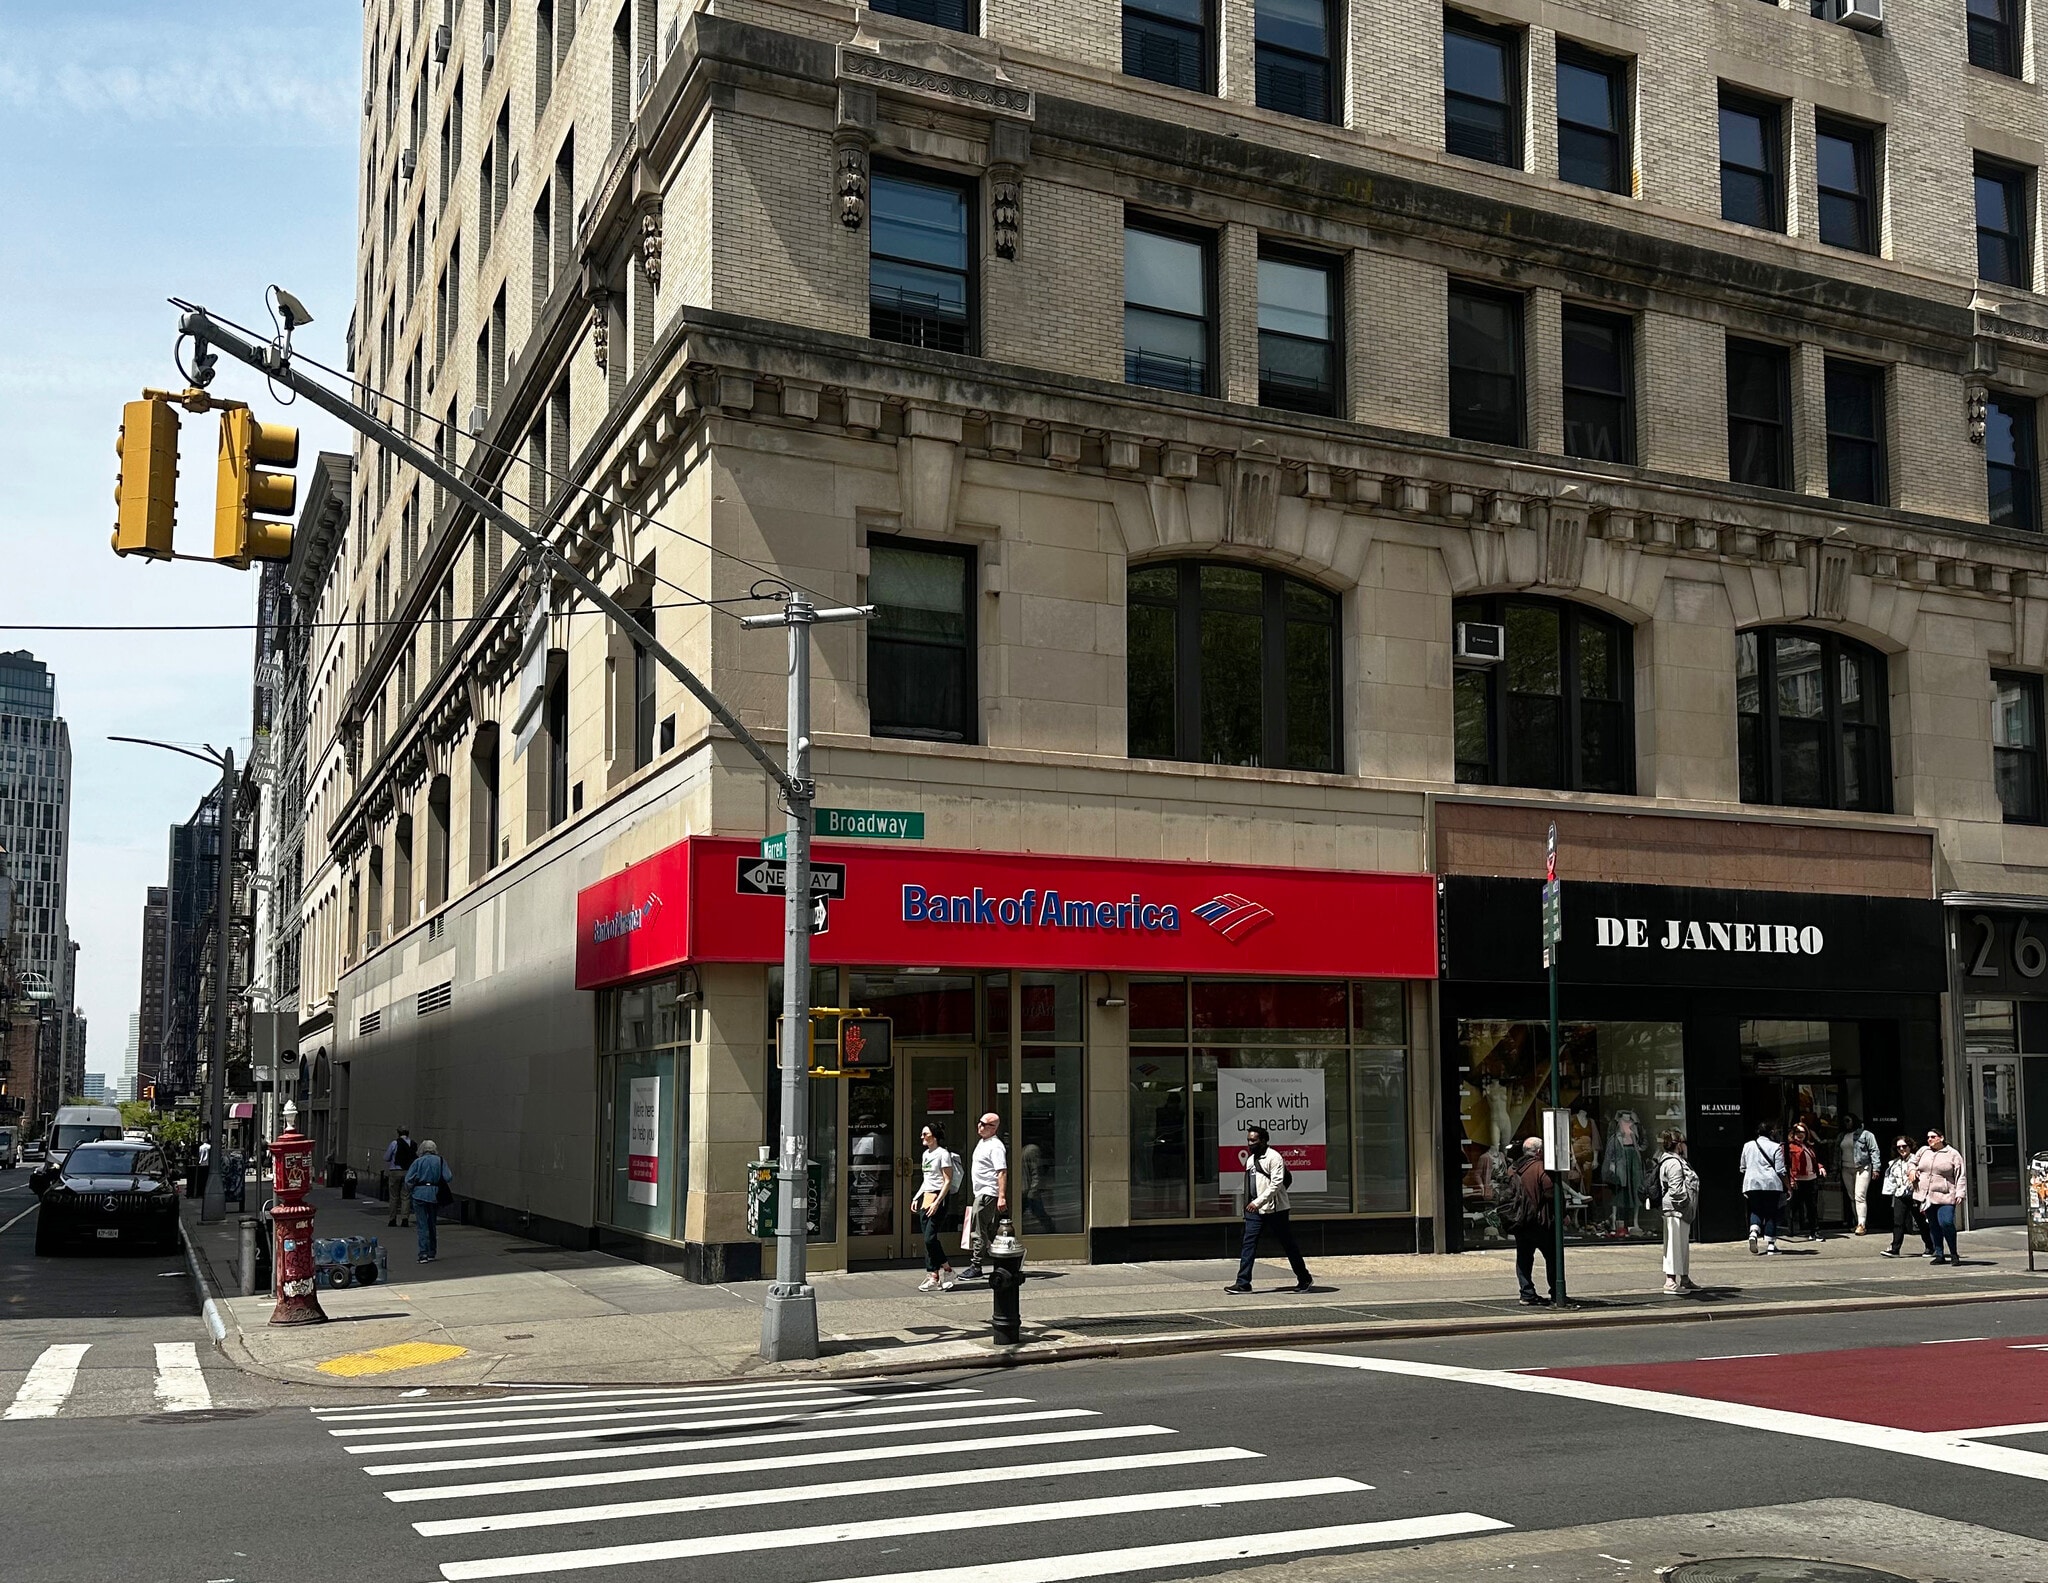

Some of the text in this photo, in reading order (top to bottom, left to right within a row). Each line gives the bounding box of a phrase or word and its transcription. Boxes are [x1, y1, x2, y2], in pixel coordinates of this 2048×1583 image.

[829, 811, 908, 838] Broadway
[763, 841, 783, 859] Warren
[755, 869, 832, 888] ONE AY
[902, 884, 1180, 931] Bank of America
[1595, 917, 1824, 955] DE JANEIRO
[1235, 1092, 1309, 1109] Bank with
[1237, 1114, 1308, 1136] us nearby
